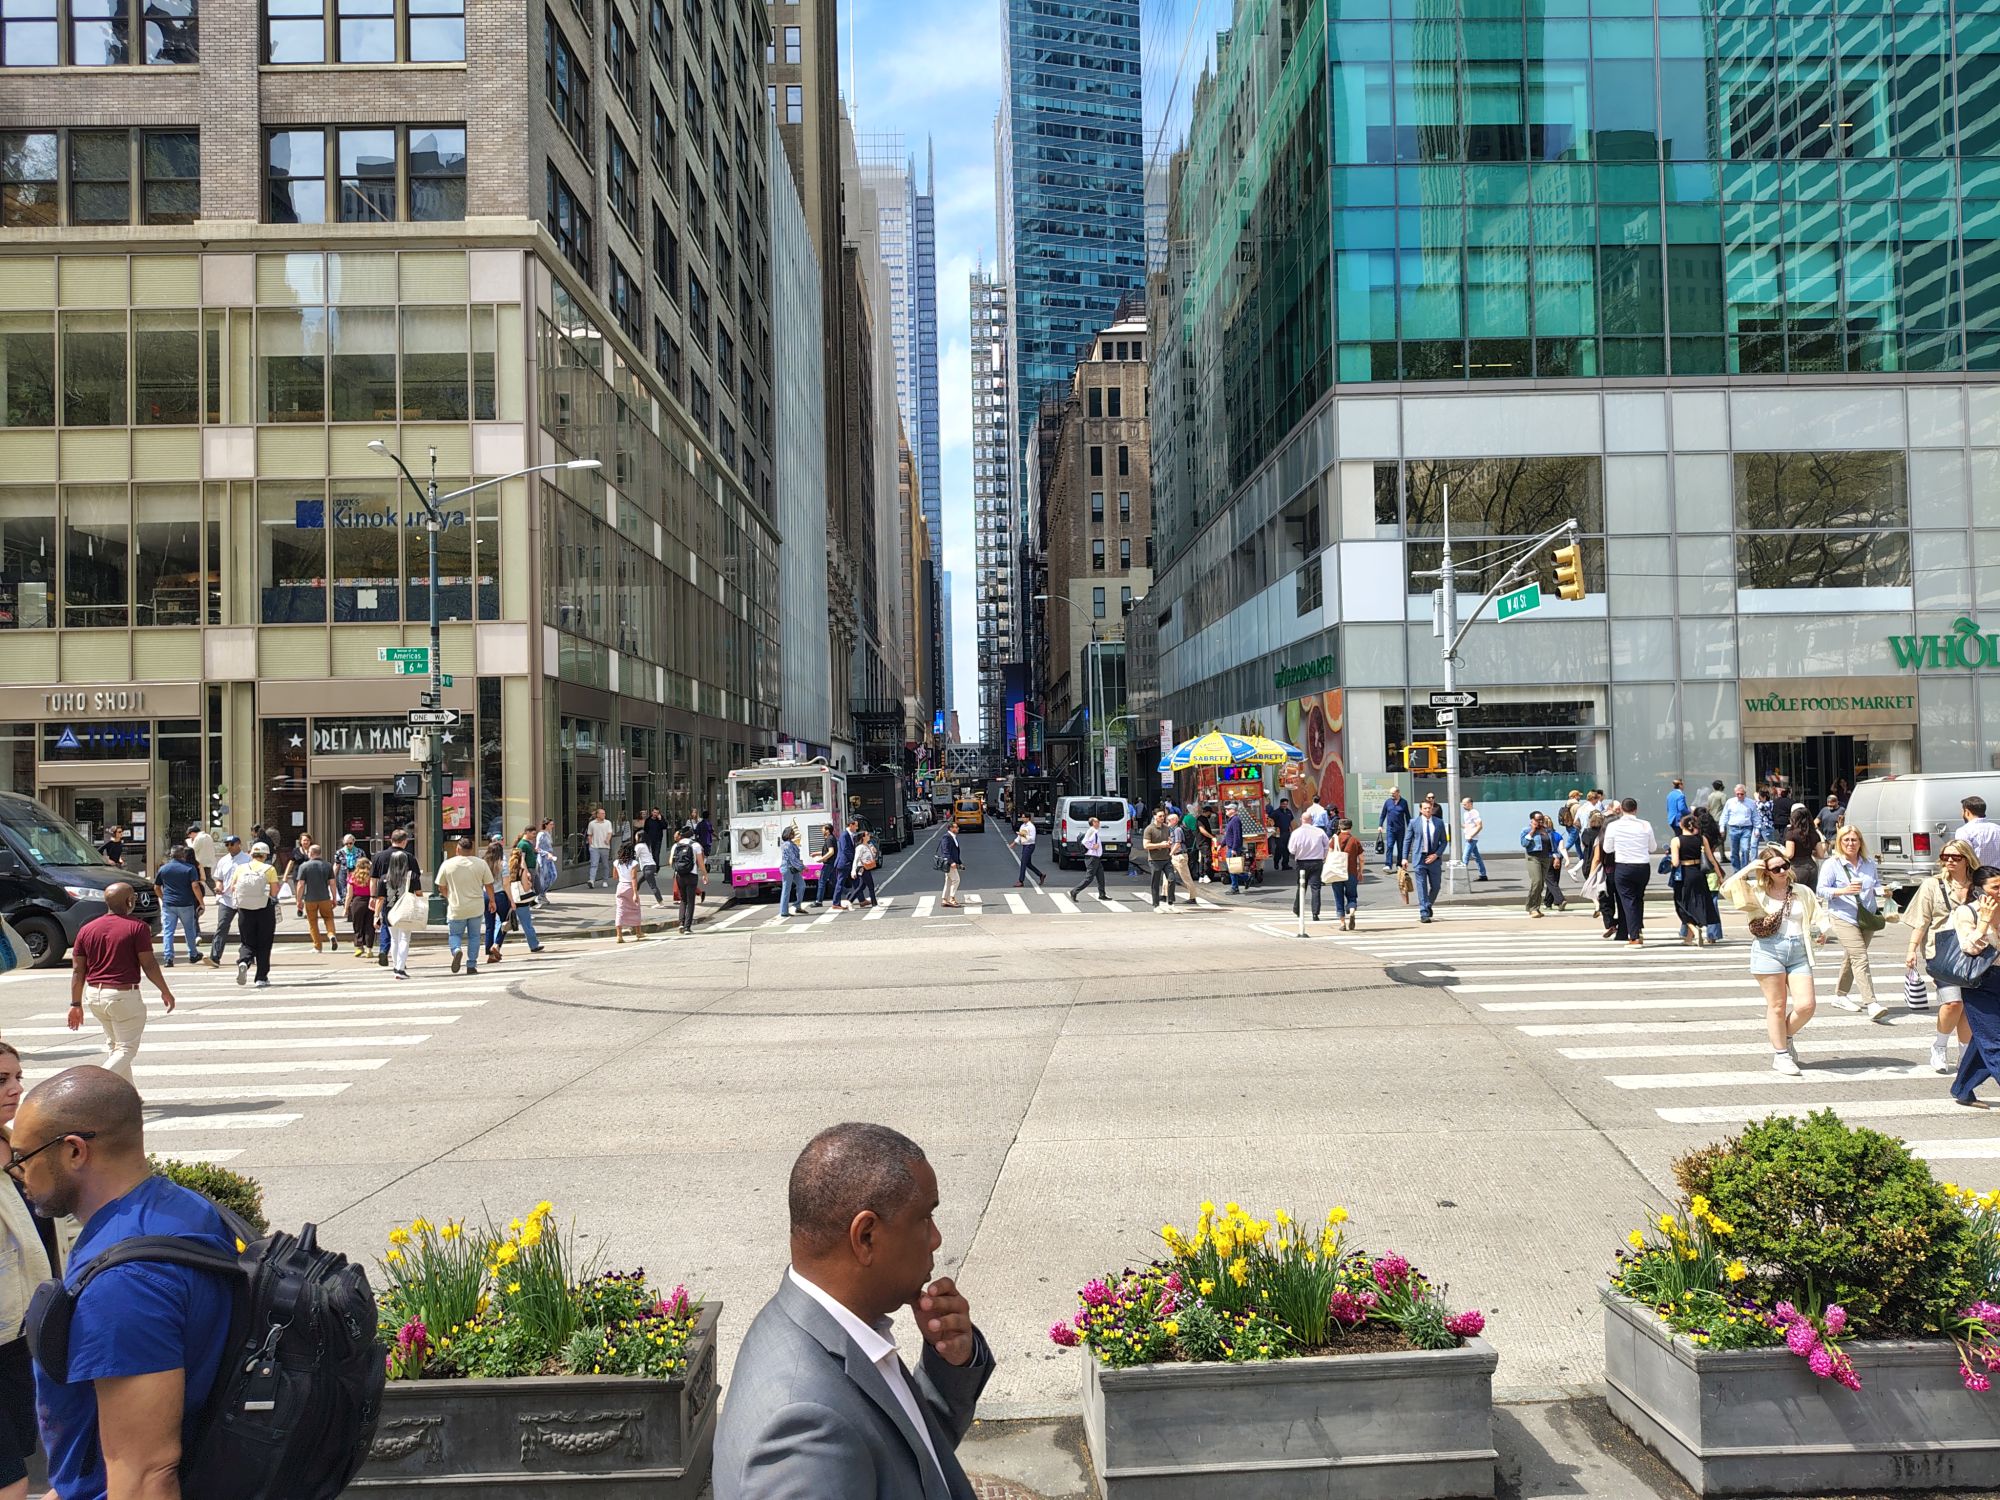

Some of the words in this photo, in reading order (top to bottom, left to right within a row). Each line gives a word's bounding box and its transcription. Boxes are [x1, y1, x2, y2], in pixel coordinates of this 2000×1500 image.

[332, 506, 467, 532] Kinokunya
[1506, 598, 1512, 613] W
[1513, 596, 1519, 610] 41
[1519, 594, 1527, 609] St
[393, 652, 422, 660] Americas
[409, 662, 414, 672] 6
[41, 692, 87, 712] TOHO
[94, 691, 145, 711] SHOJI
[1744, 692, 1799, 713] WHOLE
[1800, 696, 1849, 711] FOODS
[1850, 695, 1915, 710] MARKET
[313, 727, 349, 750] PRET
[354, 728, 364, 750] A
[1223, 767, 1260, 780] PITA
